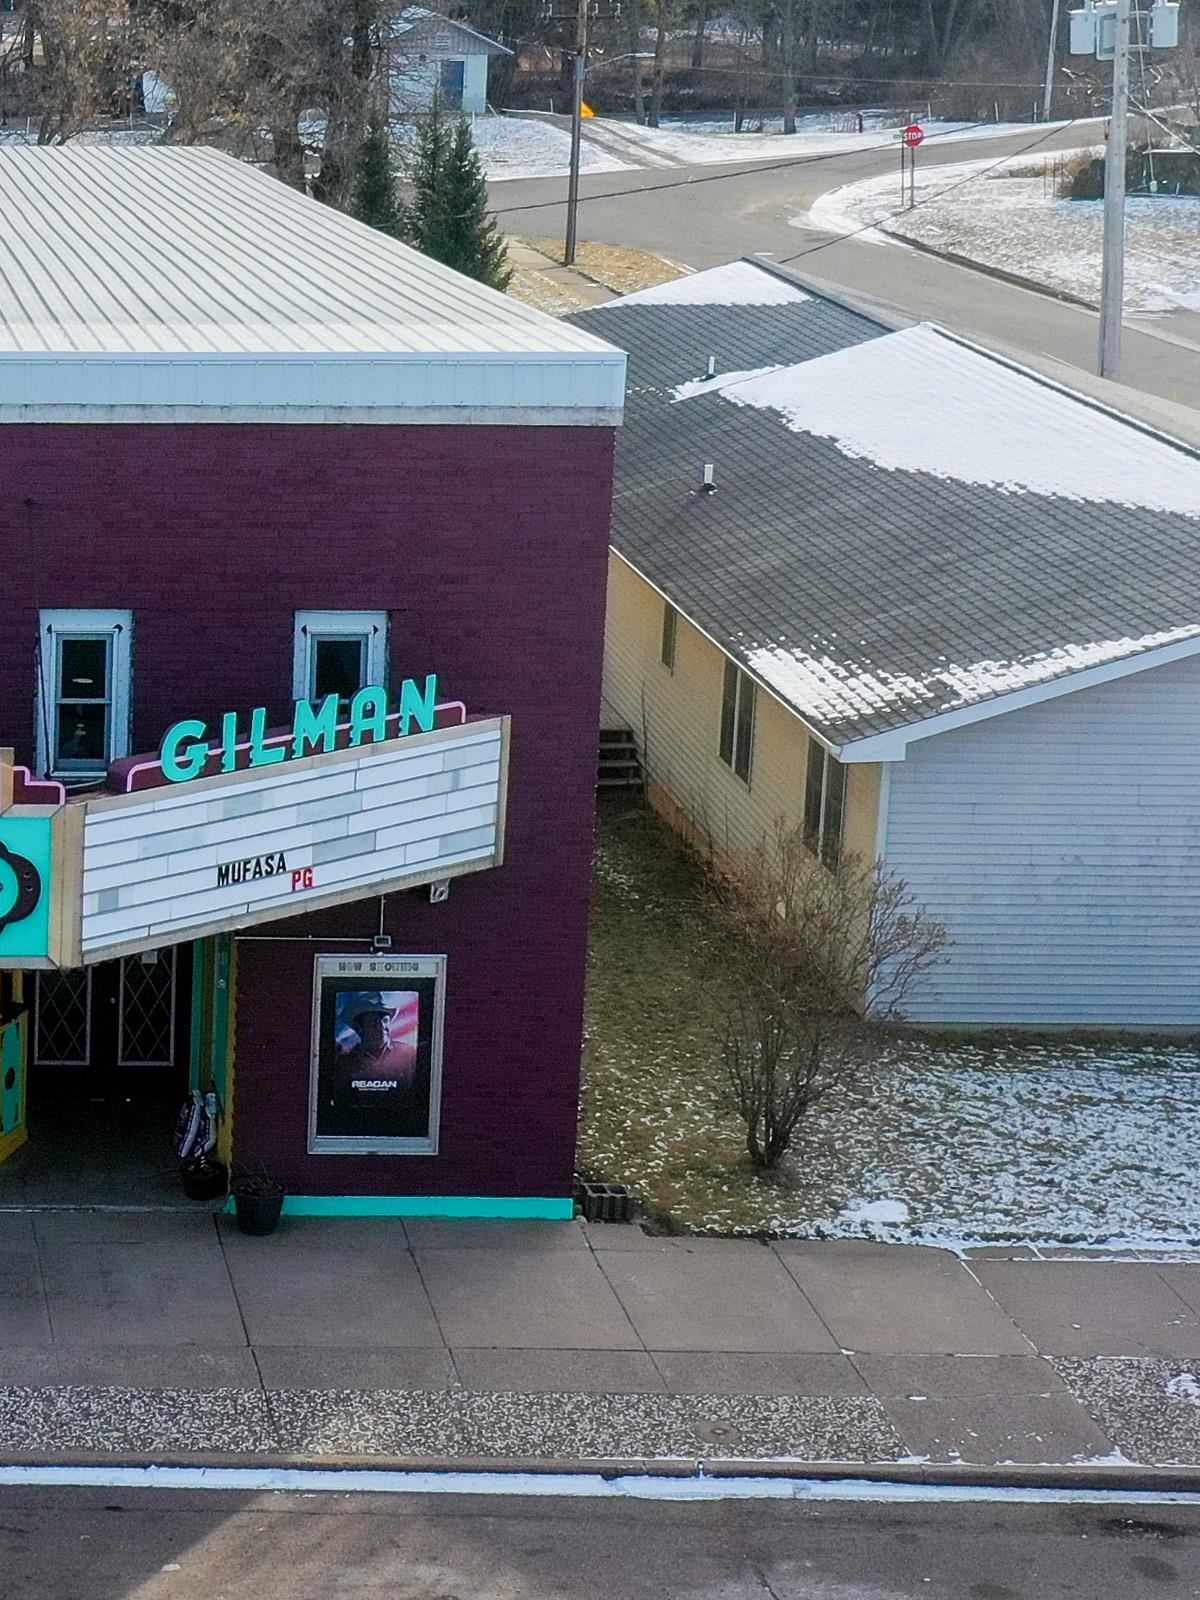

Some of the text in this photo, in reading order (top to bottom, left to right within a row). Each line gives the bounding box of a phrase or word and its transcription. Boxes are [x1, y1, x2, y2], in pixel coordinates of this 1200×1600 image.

[903, 132, 923, 141] STOP
[159, 674, 437, 782] GILMAN
[217, 852, 287, 888] MUFASA
[291, 868, 313, 892] PG
[351, 1080, 397, 1088] REAGAN
